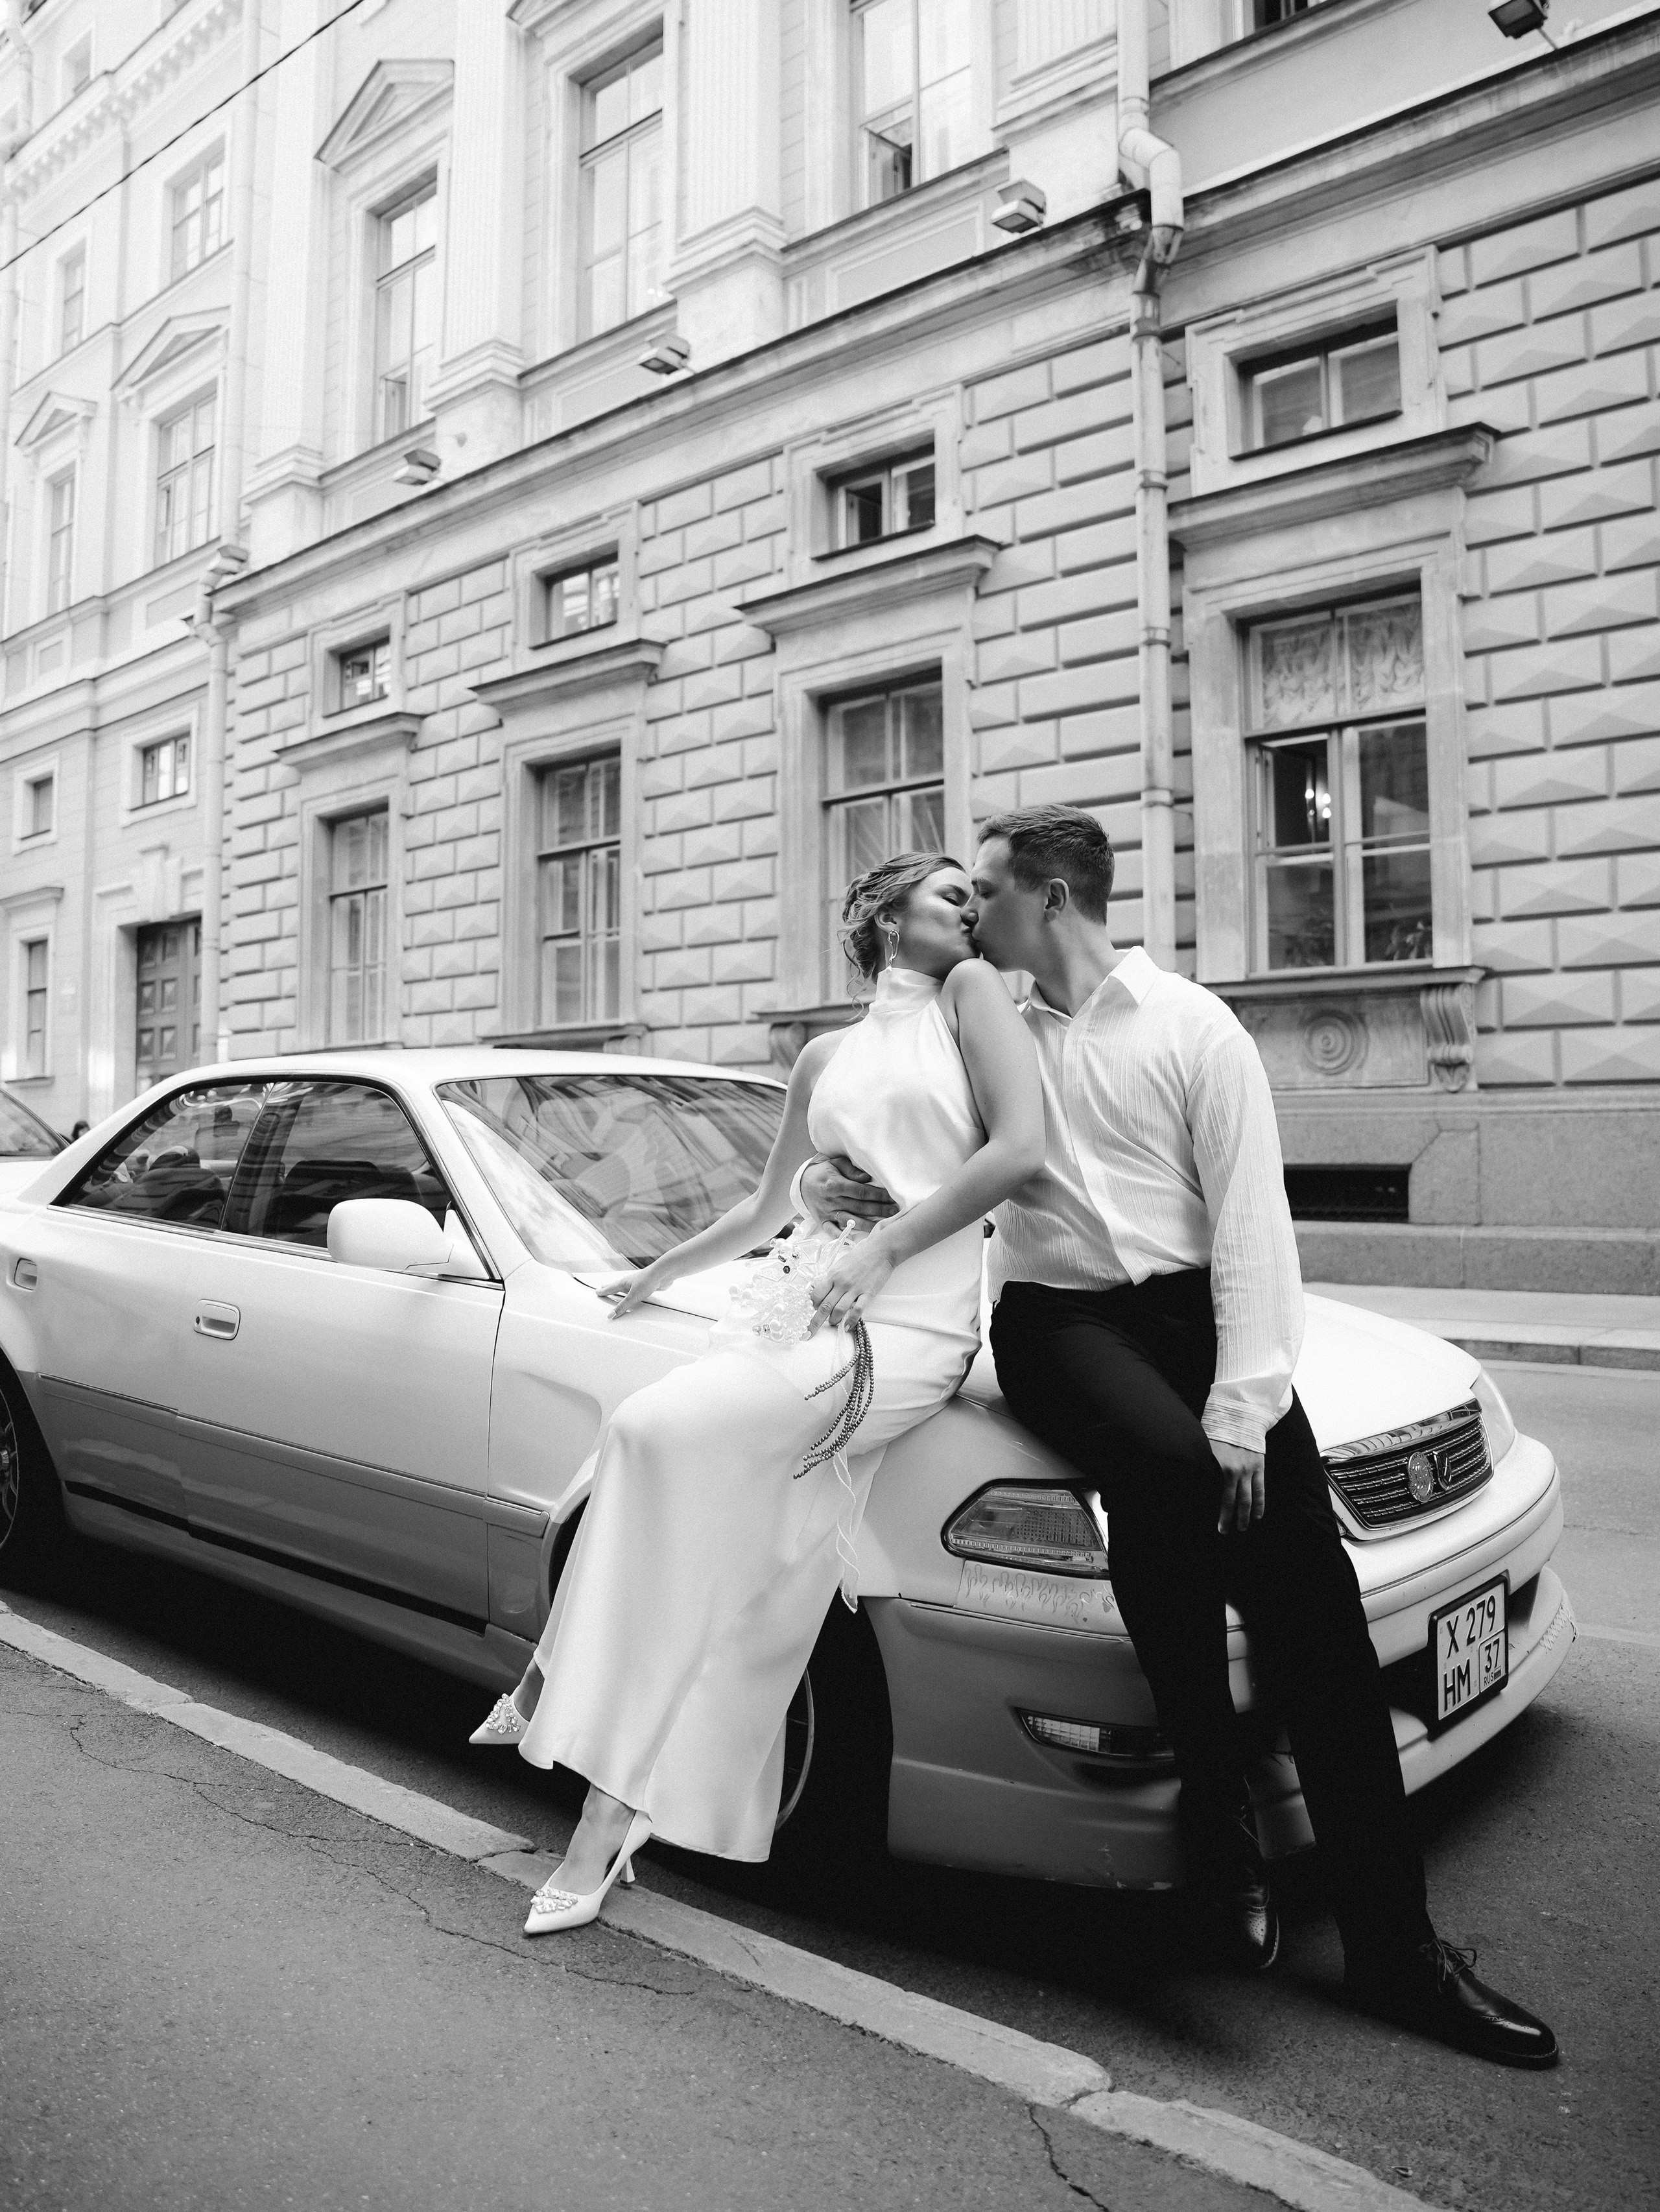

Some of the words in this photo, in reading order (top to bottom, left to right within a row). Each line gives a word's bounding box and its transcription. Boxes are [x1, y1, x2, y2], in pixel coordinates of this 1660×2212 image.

[1446, 1615, 1459, 1659] X
[1466, 1595, 1496, 1647] 279
[1484, 1637, 1500, 1673] 37
[1443, 1658, 1471, 1712] HM
[1484, 1672, 1495, 1687] RUS
